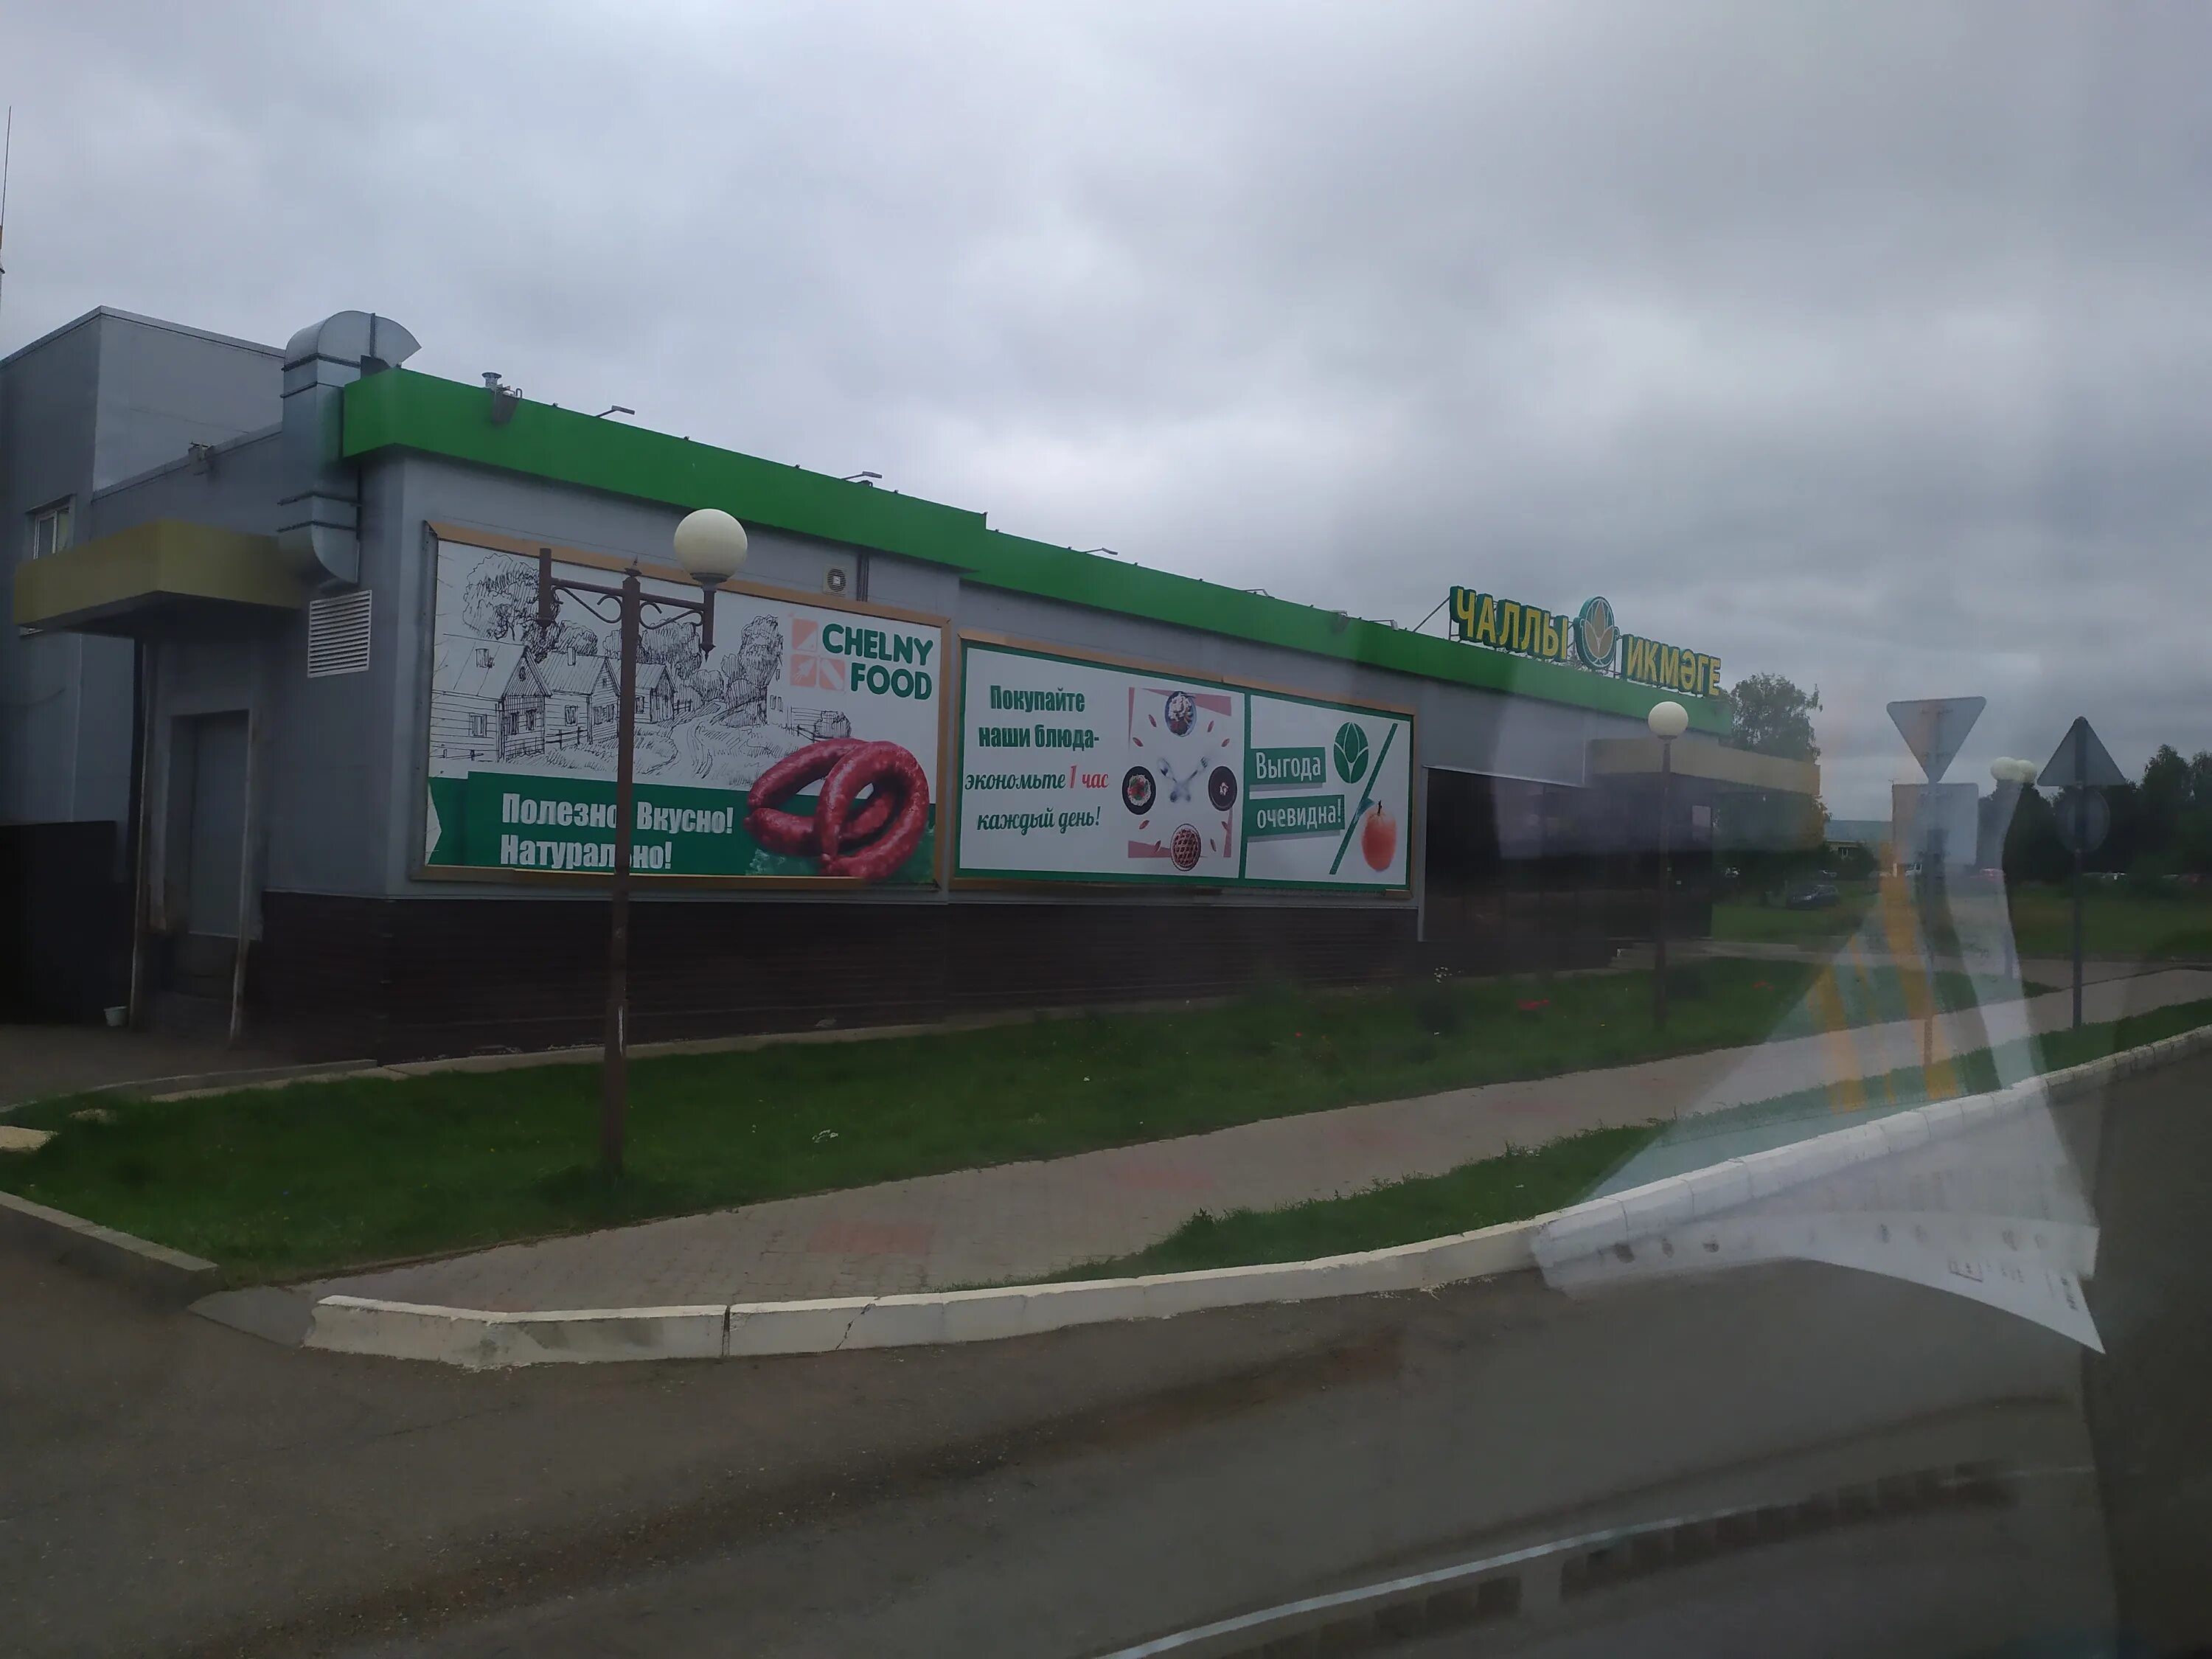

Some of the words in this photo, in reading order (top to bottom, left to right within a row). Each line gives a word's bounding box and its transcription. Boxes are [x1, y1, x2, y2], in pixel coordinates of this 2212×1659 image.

[822, 623, 933, 665] CHELNY
[1450, 585, 1569, 663] ЧАЛЛЫ
[1622, 633, 1722, 696] ИКМӘГЕ
[851, 662, 933, 700] FOOD
[990, 685, 1085, 712] Покупайте
[978, 726, 1031, 747] наши
[1034, 724, 1099, 751] блюда-
[965, 772, 1065, 790] экономьте
[1069, 765, 1077, 790] 1
[1081, 772, 1109, 790] час
[1256, 752, 1321, 780] Выгода
[636, 801, 733, 834] Вкусно!
[977, 807, 1055, 835] каждый
[1058, 806, 1101, 834] день!
[1256, 799, 1341, 830] очевидна!
